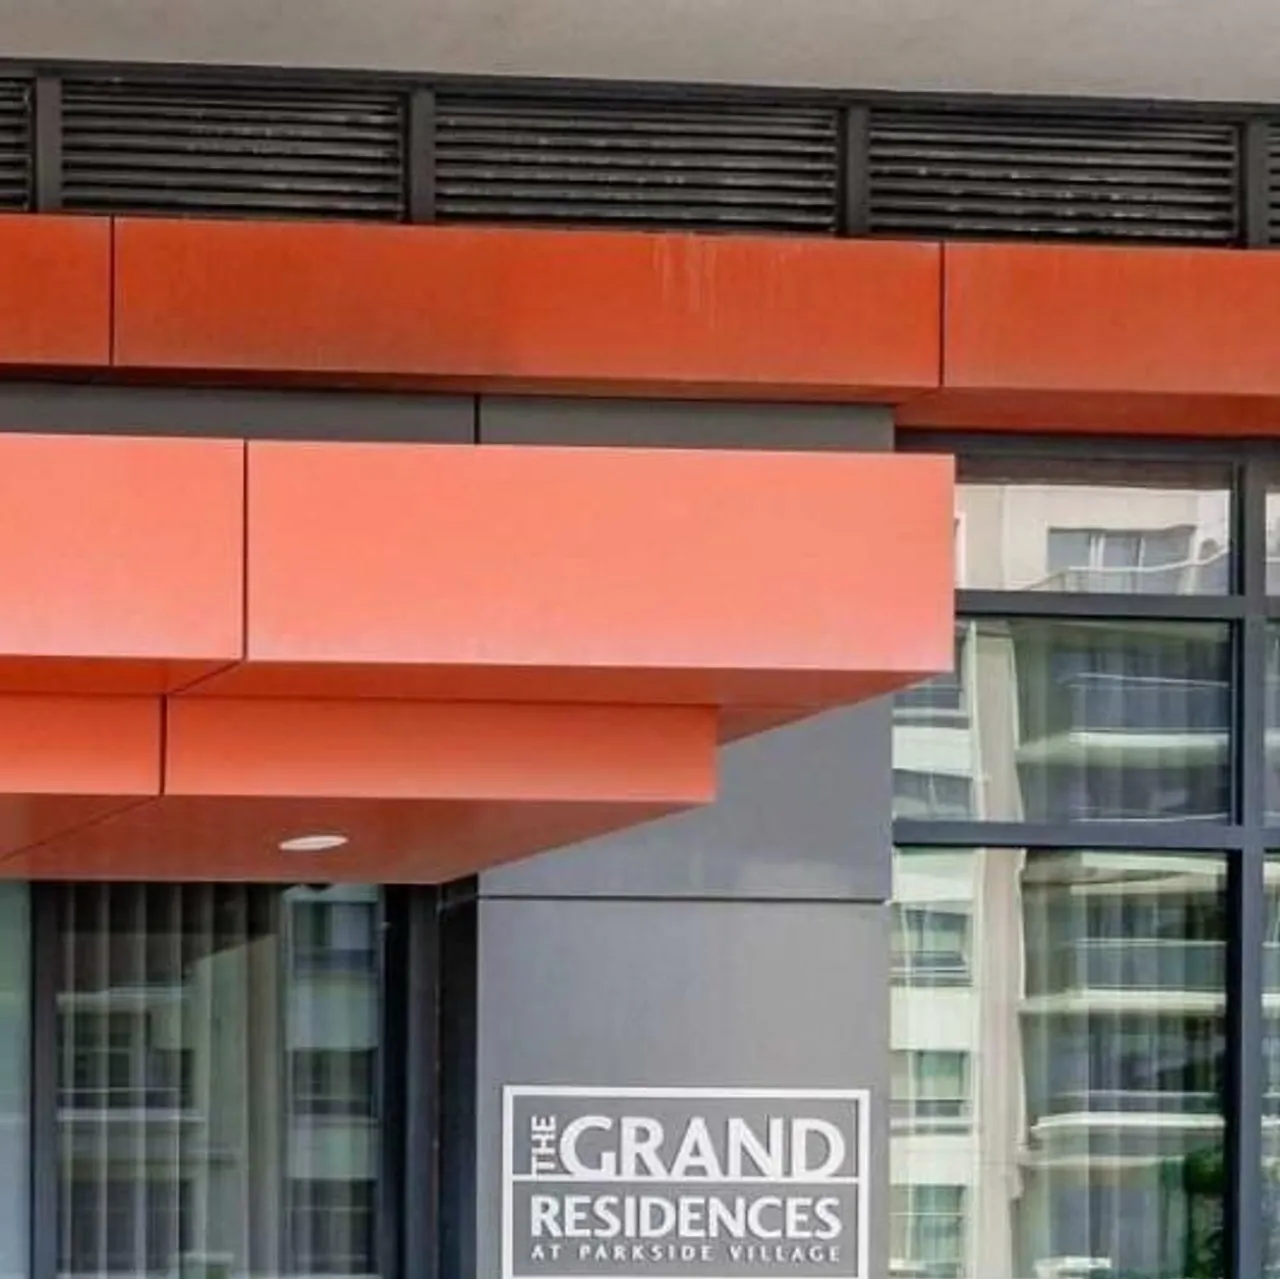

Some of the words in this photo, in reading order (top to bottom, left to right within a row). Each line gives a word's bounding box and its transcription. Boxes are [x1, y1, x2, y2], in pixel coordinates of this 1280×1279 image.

[530, 1114, 557, 1176] THE
[559, 1115, 847, 1178] GRAND
[530, 1194, 843, 1240] RESIDENCES
[530, 1244, 562, 1261] AT
[578, 1245, 714, 1262] PARKSIDE
[729, 1245, 841, 1263] VILLAGE
